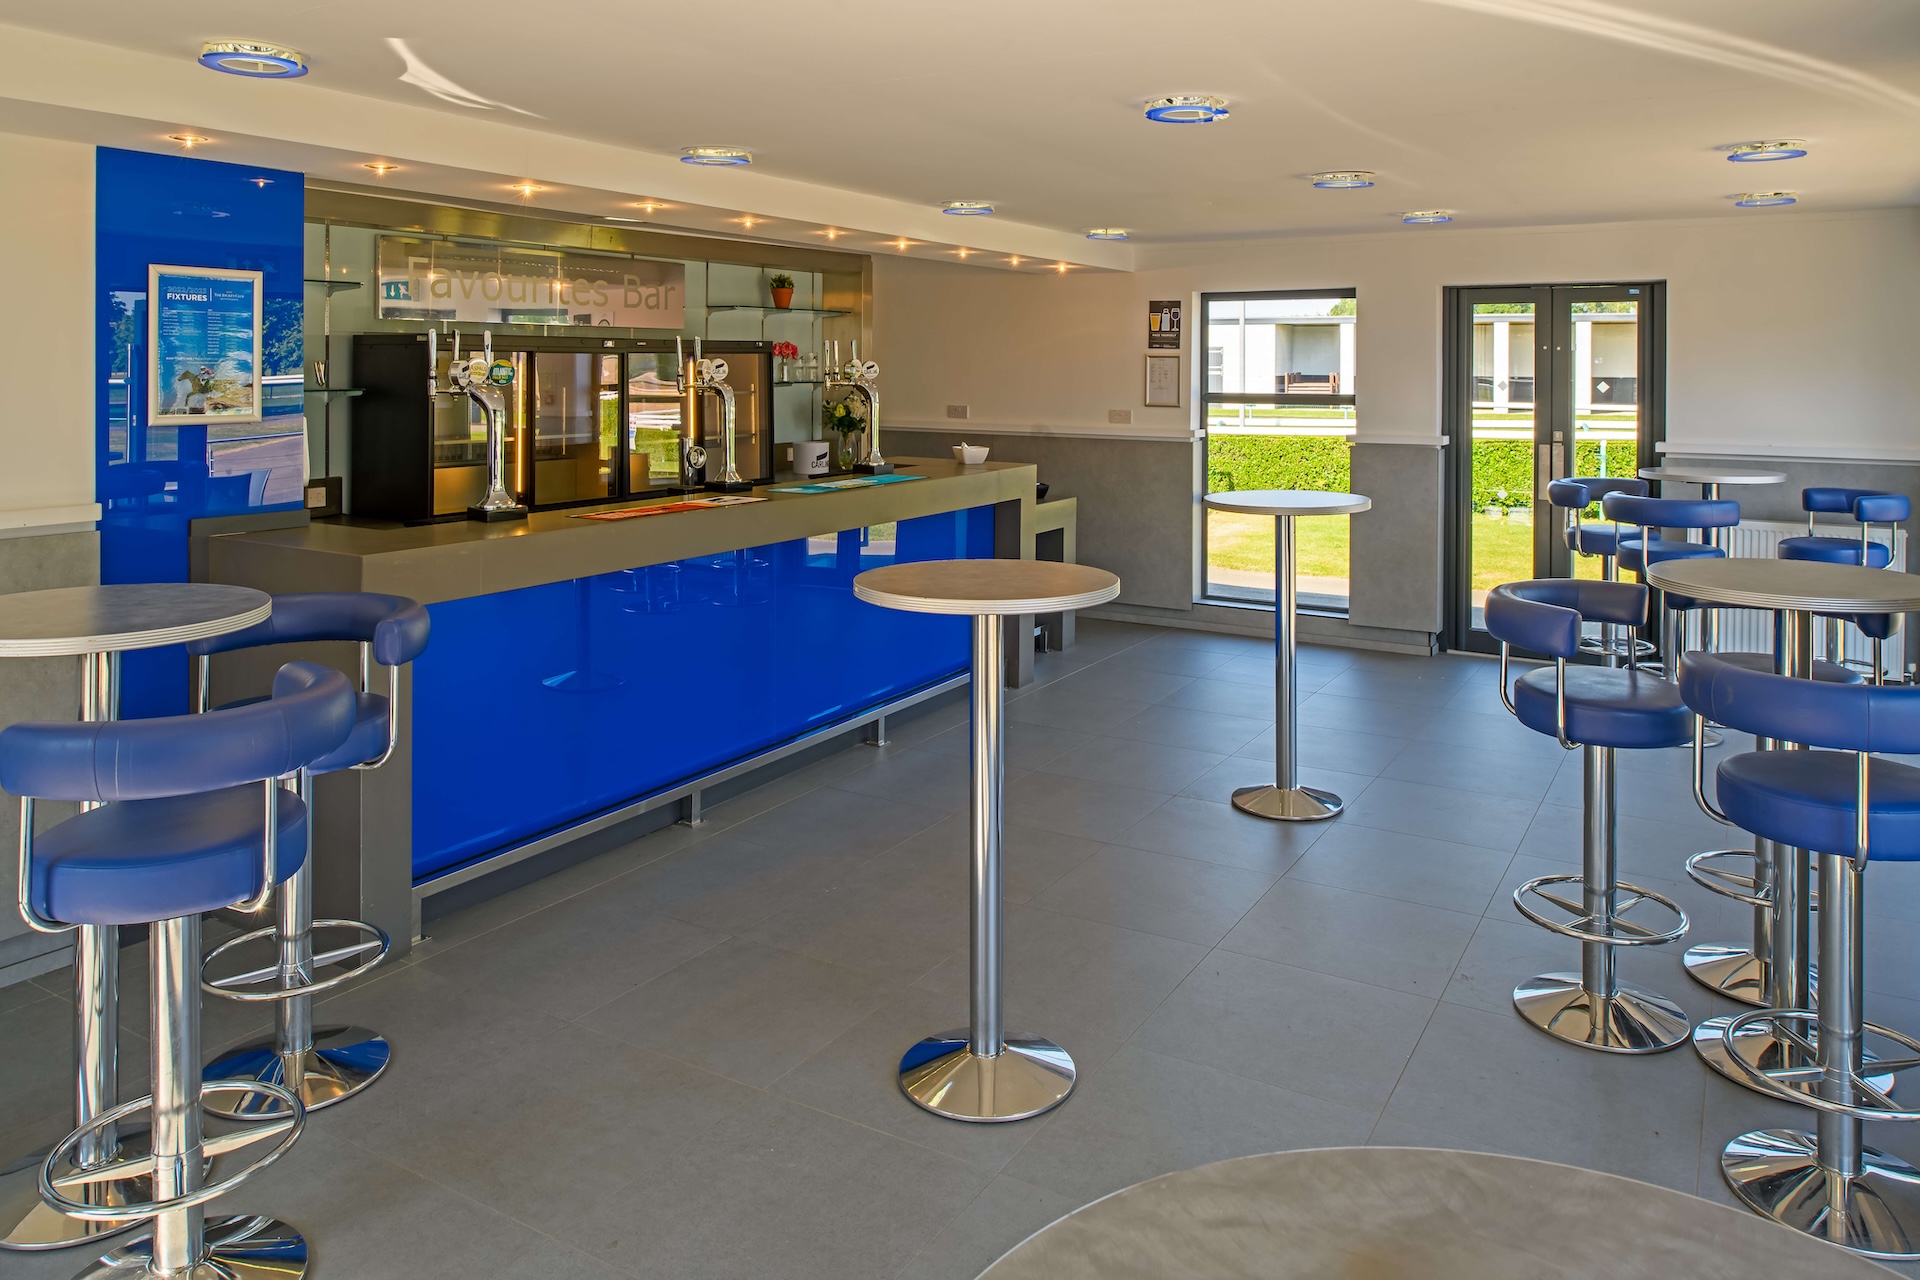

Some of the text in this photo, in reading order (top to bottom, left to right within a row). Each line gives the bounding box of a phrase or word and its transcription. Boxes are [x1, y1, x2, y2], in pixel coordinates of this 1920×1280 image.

[166, 292, 208, 302] FIXTURES
[407, 256, 676, 310] Favourites Bar
